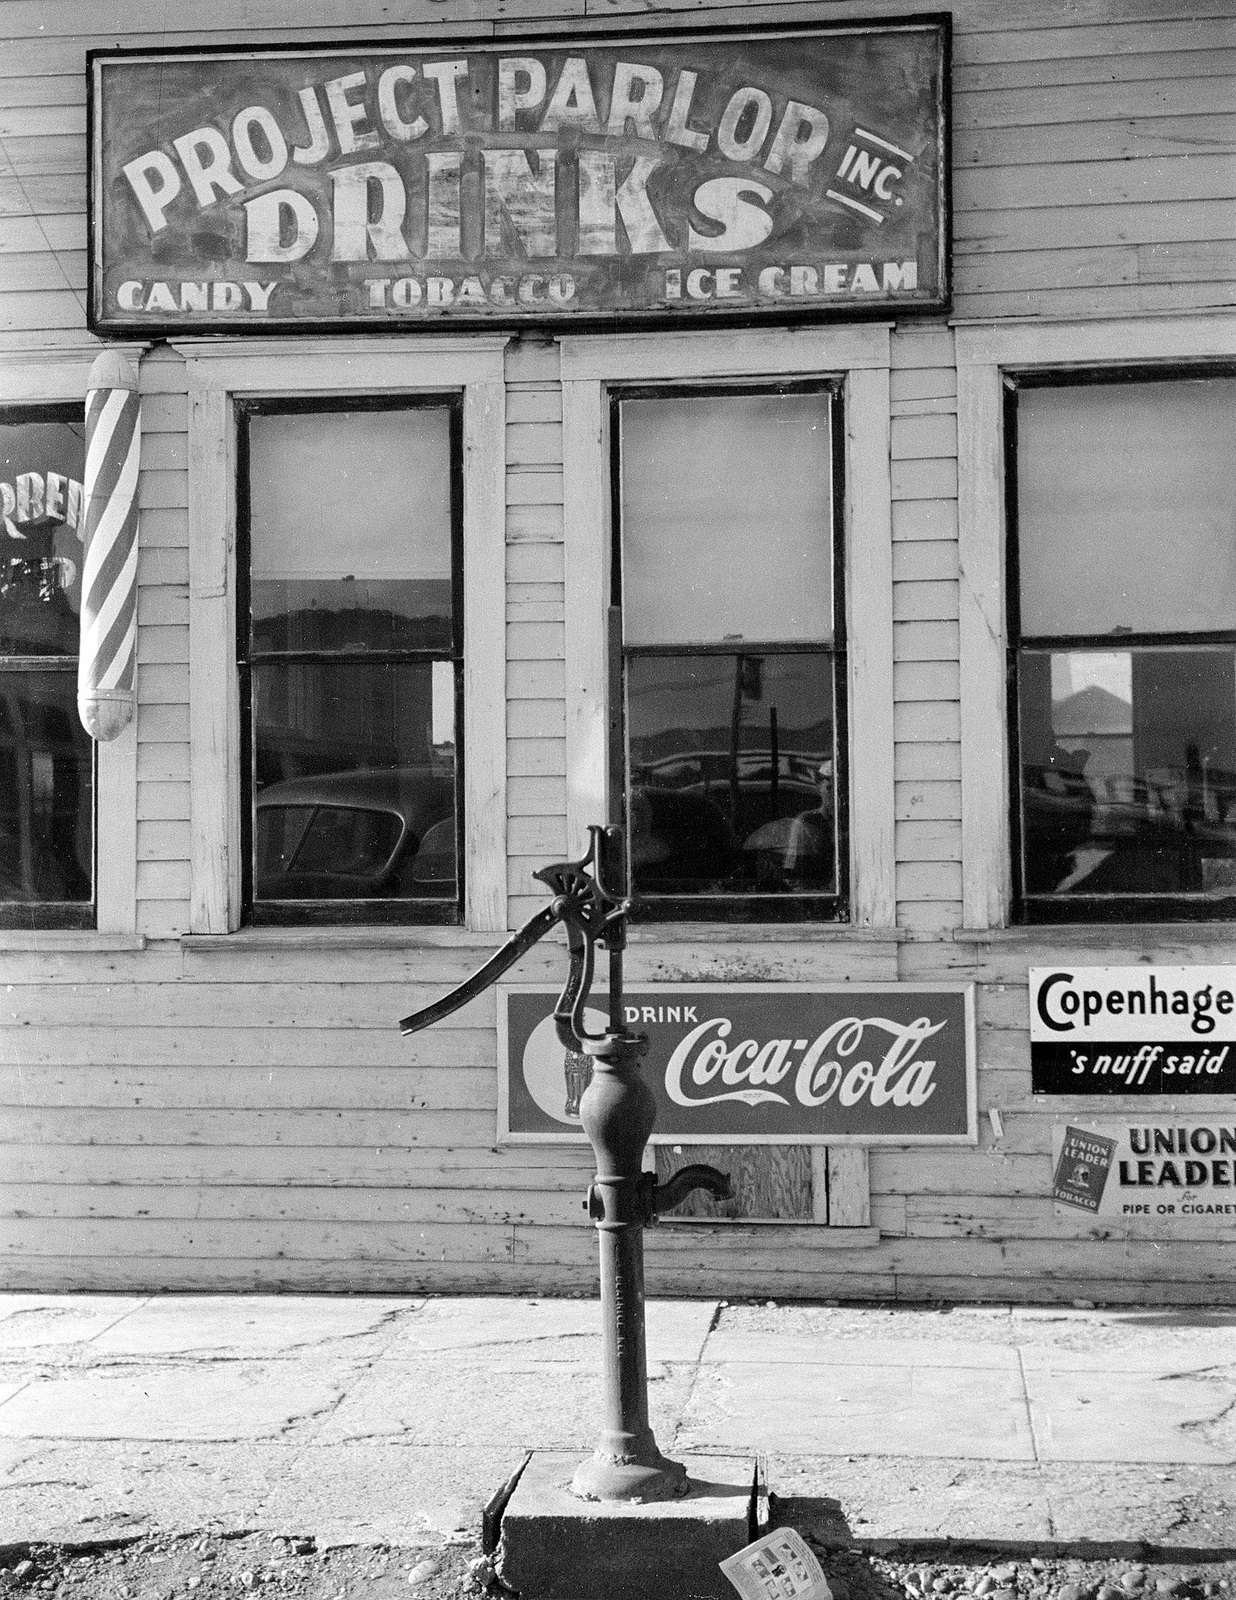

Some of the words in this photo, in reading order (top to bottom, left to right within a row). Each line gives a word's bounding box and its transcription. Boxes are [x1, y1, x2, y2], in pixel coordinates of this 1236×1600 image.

[123, 60, 468, 233] PROJECT
[498, 57, 830, 188] PARLOR
[836, 145, 903, 207] INC.
[244, 149, 774, 263] DRINKS
[117, 280, 278, 312] CANDY
[364, 273, 576, 308] TOBACCO
[666, 268, 742, 299] ICE
[758, 261, 918, 295] CREAM
[625, 1006, 698, 1023] DRINK
[1037, 972, 1235, 1035] Copenhage
[664, 1017, 949, 1107] Coca-Cola
[1070, 1050, 1088, 1074] 's
[1092, 1045, 1165, 1085] nuff
[1162, 1046, 1230, 1075] said
[1064, 1146, 1109, 1168] LEADER
[1070, 1137, 1109, 1157] UNION
[1129, 1127, 1236, 1157] UNION
[1119, 1160, 1236, 1188] LEADE
[1054, 1189, 1098, 1209] TOBACCO
[1122, 1204, 1150, 1214] PIPE
[1157, 1204, 1175, 1214] OR
